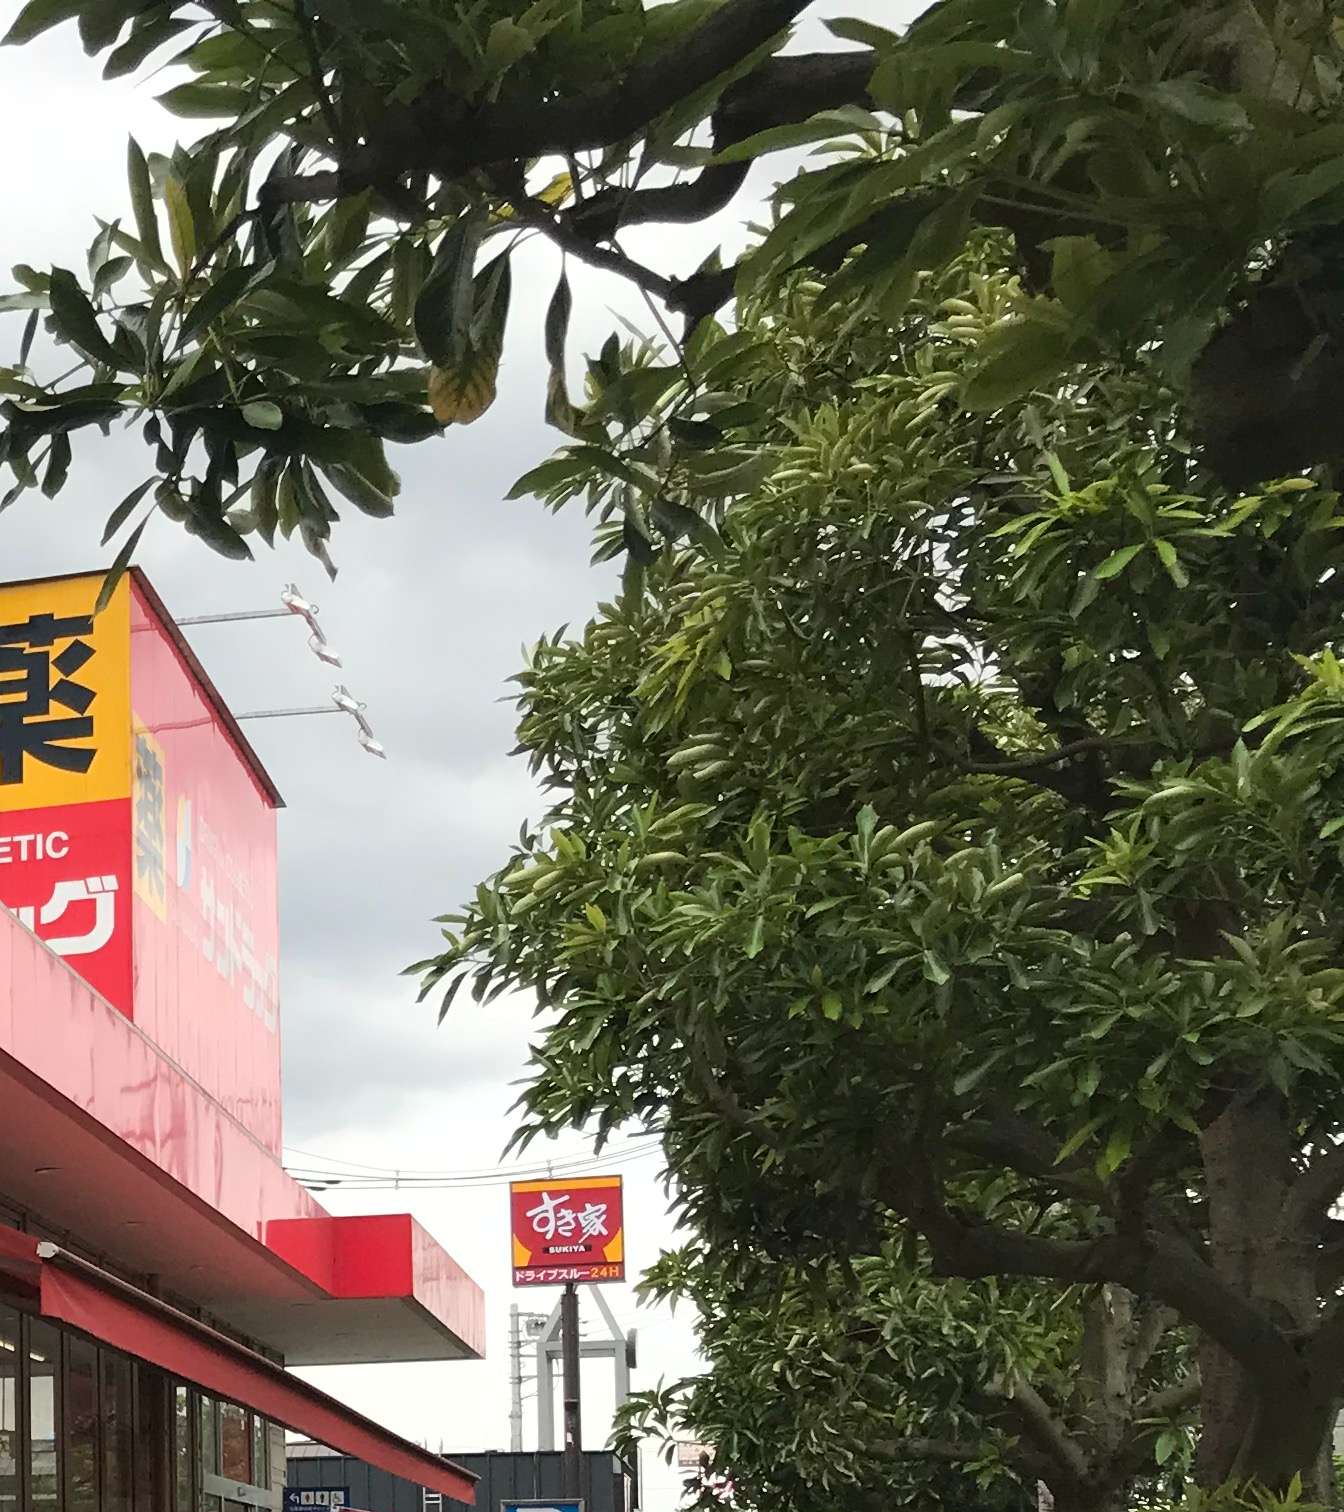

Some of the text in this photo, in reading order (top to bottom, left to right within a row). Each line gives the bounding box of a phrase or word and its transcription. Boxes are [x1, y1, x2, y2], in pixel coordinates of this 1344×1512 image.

[525, 1191, 609, 1244] すき家
[548, 1245, 587, 1255] SUKIYA
